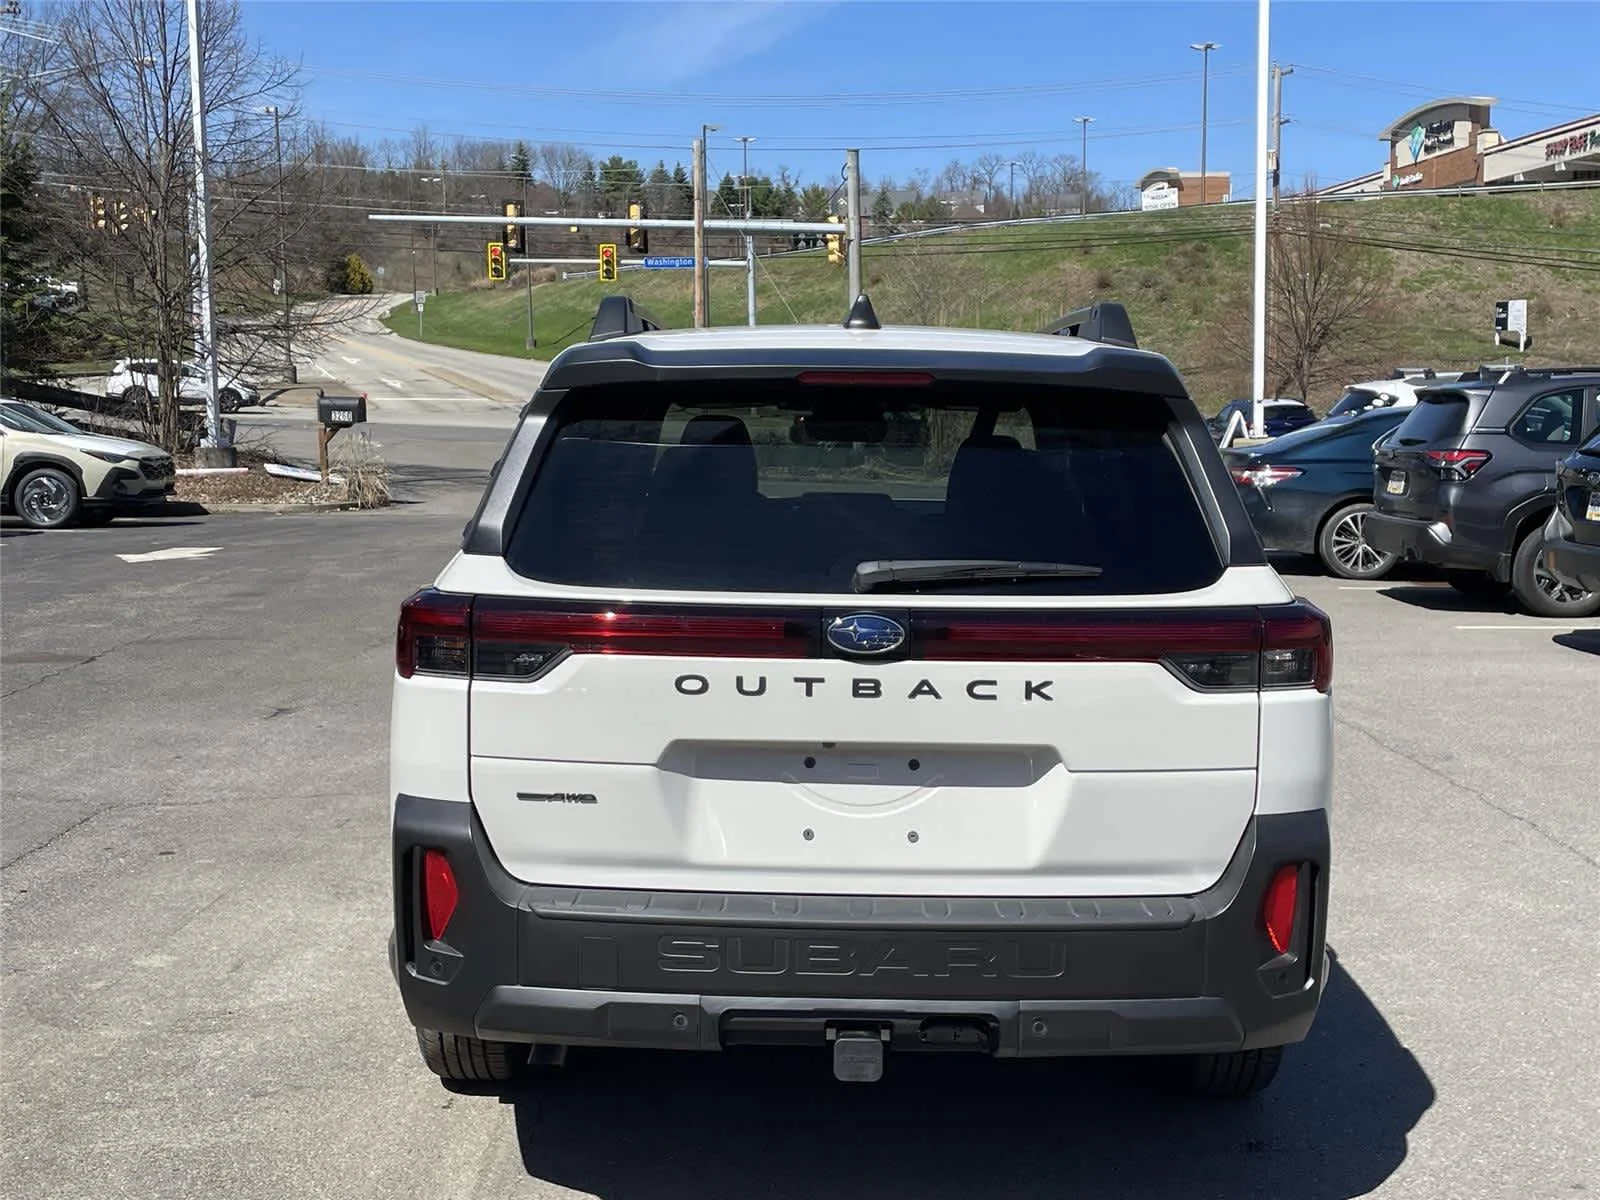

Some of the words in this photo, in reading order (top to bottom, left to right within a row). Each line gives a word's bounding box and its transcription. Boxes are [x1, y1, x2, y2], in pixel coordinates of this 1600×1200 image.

[647, 258, 693, 267] Washington
[674, 674, 1054, 701] OUTBACK
[657, 934, 1067, 979] SUBARU
